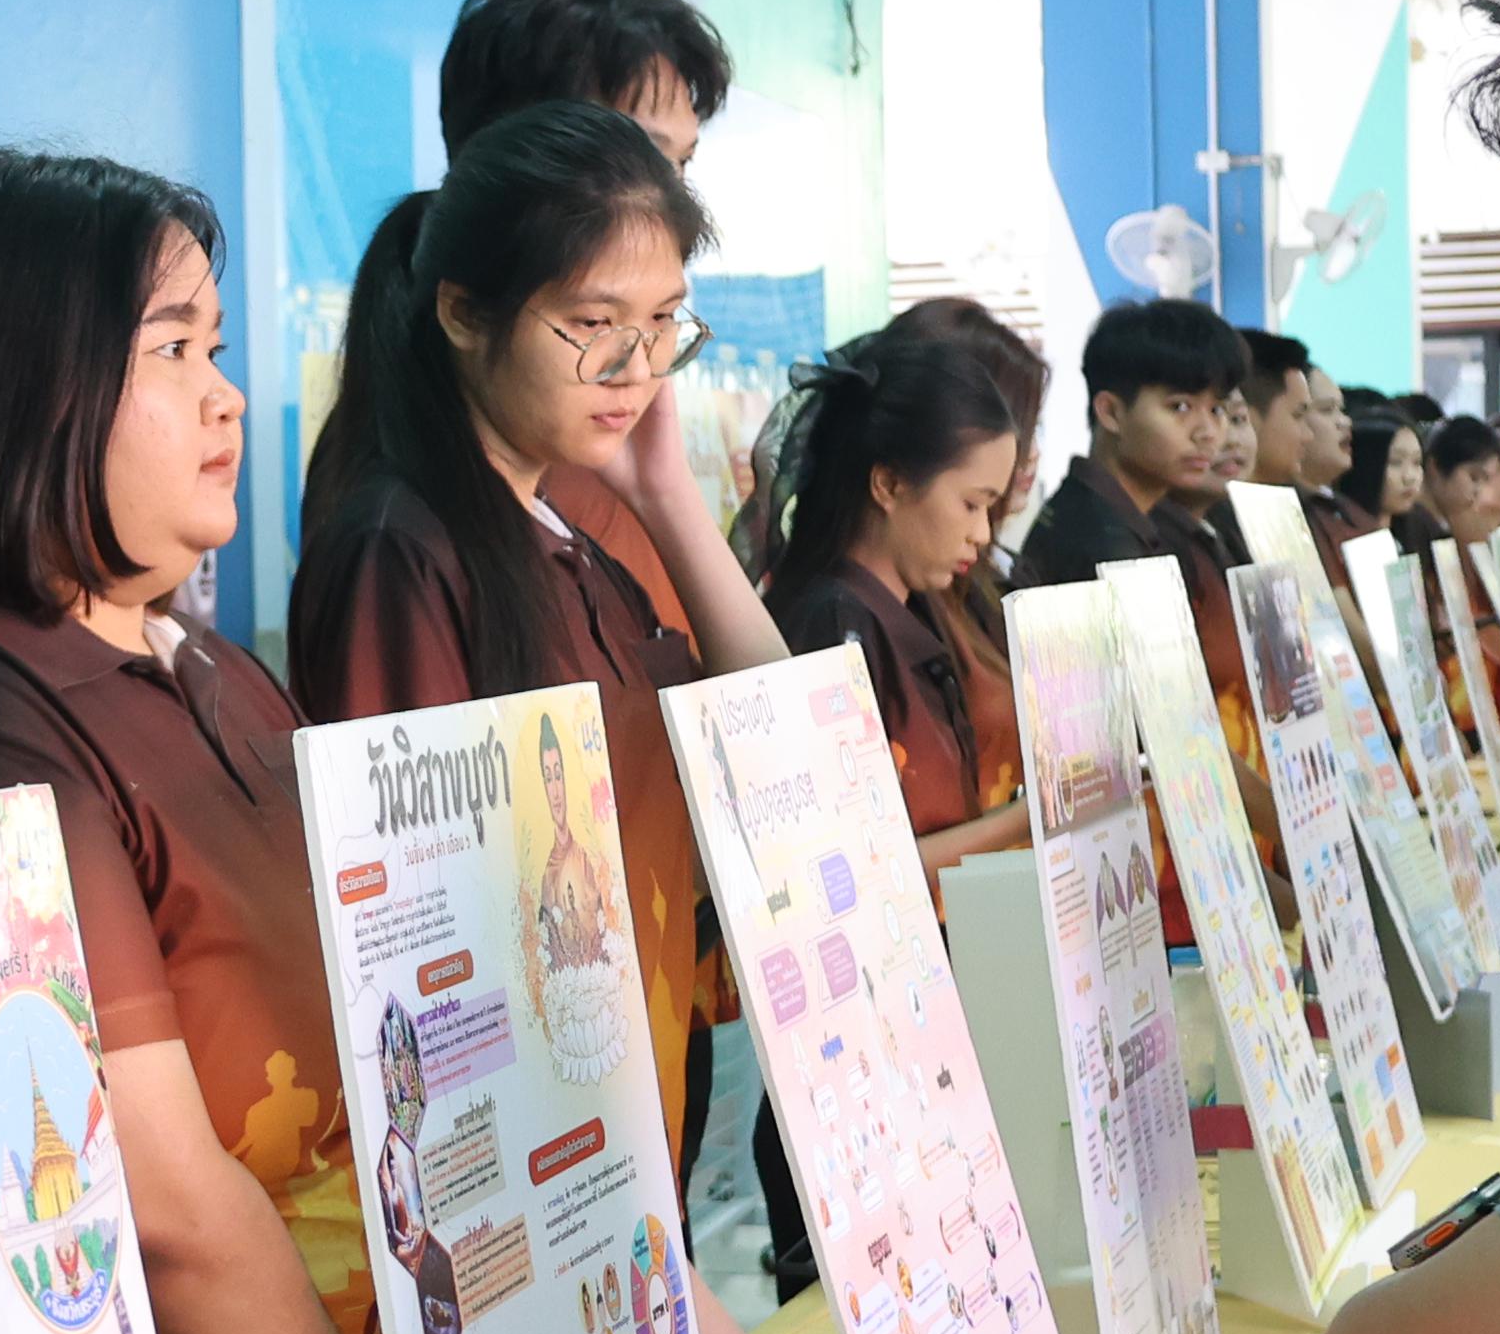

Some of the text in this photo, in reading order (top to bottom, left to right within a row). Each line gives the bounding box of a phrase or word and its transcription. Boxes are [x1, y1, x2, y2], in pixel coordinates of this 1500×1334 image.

[717, 679, 775, 736] ประเพณี
[367, 724, 512, 849] วันวิสาขบูชา
